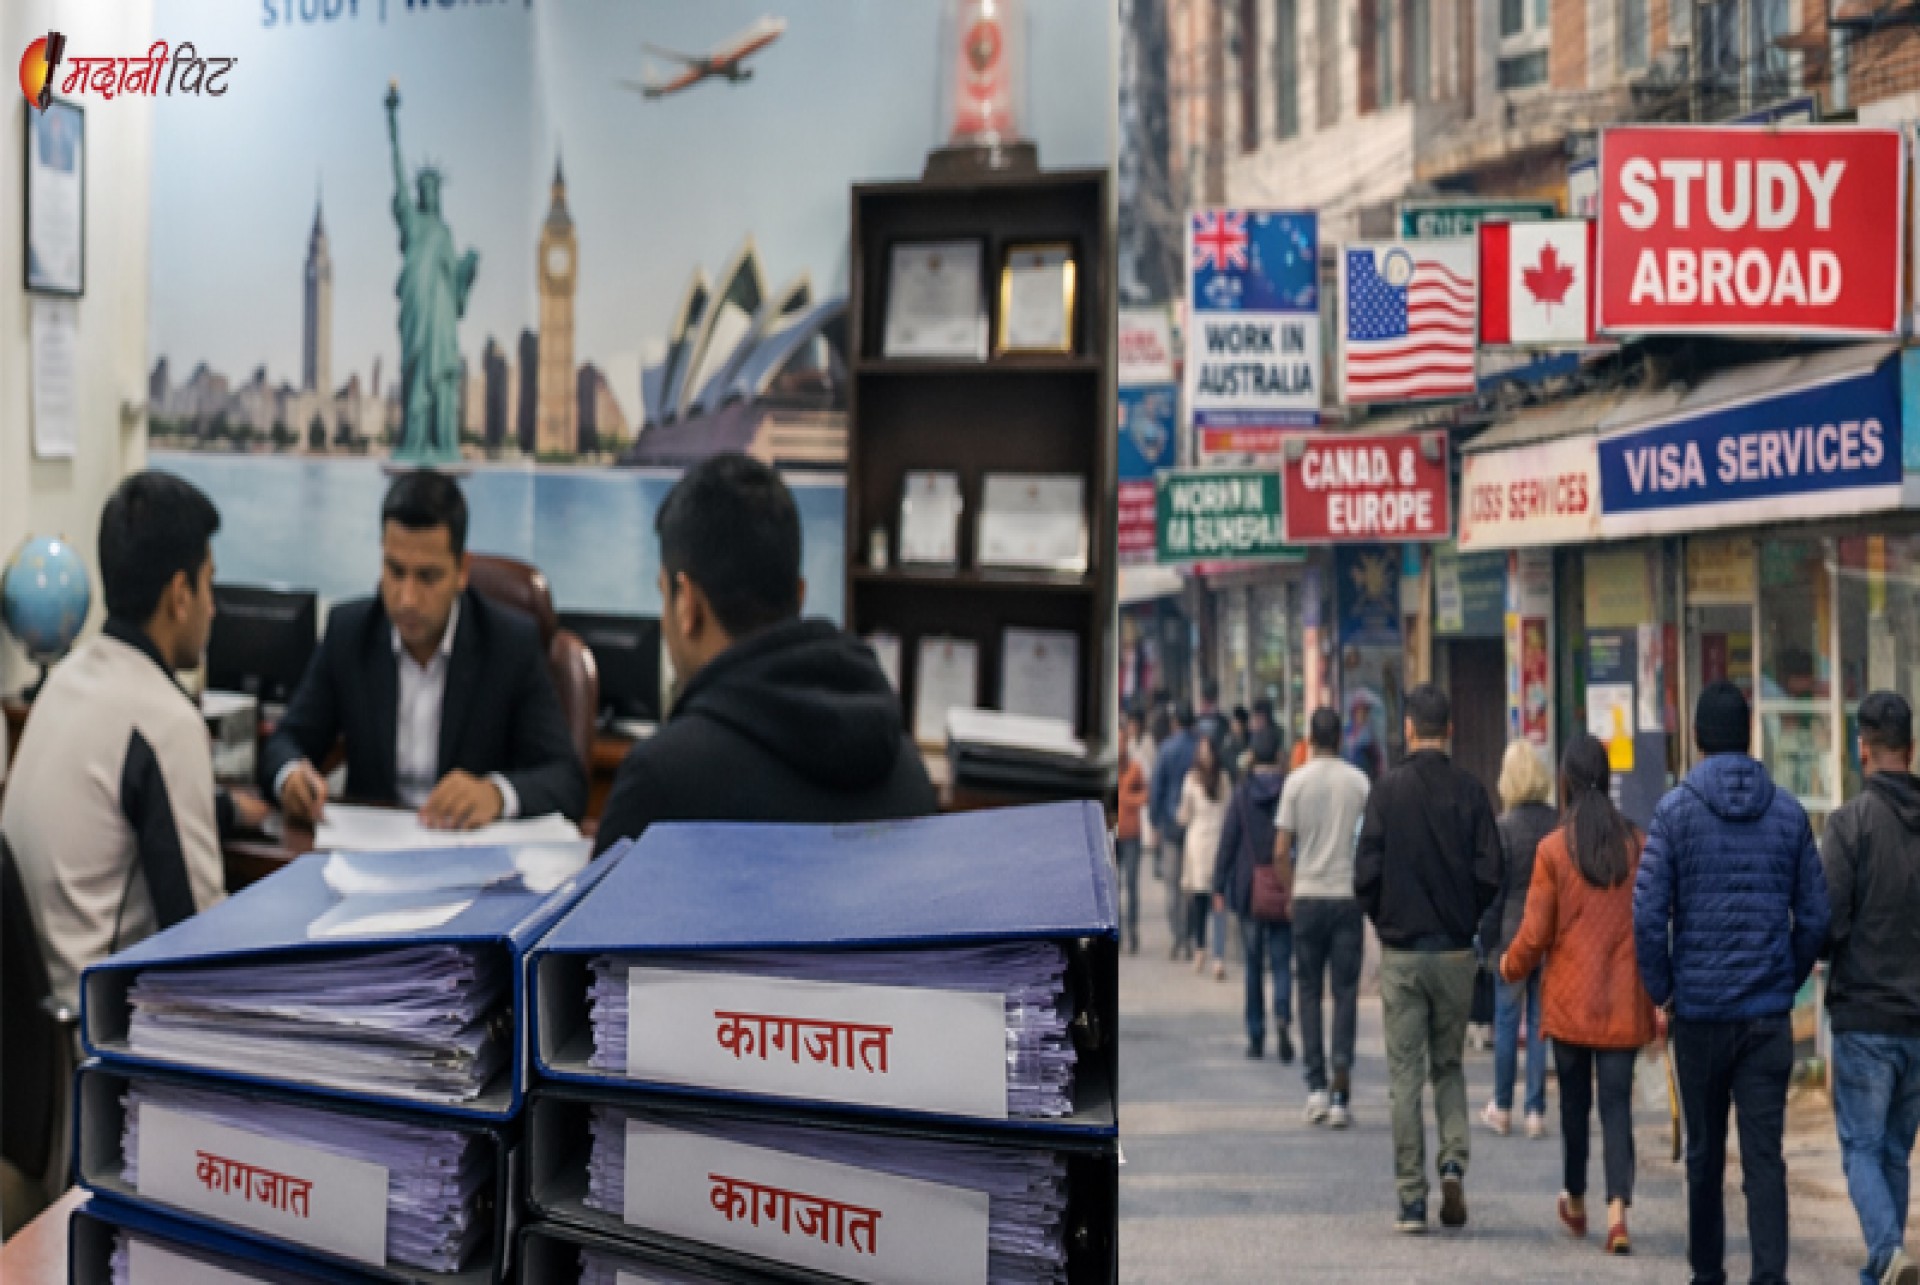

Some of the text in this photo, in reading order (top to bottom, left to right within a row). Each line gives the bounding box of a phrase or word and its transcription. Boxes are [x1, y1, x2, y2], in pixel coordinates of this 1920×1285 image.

[1619, 157, 1846, 231] STUDY
[1629, 249, 1842, 306] ABROAD
[1205, 323, 1273, 354] WORK
[1281, 323, 1304, 354] IN
[1199, 362, 1313, 396] AUSTRALIA
[1624, 418, 1884, 495] VISA SERVICES
[1327, 489, 1434, 533] EUROPE
[714, 1009, 894, 1073] कागजात
[195, 1149, 314, 1218] कागजात
[707, 1172, 883, 1255] कागजात
